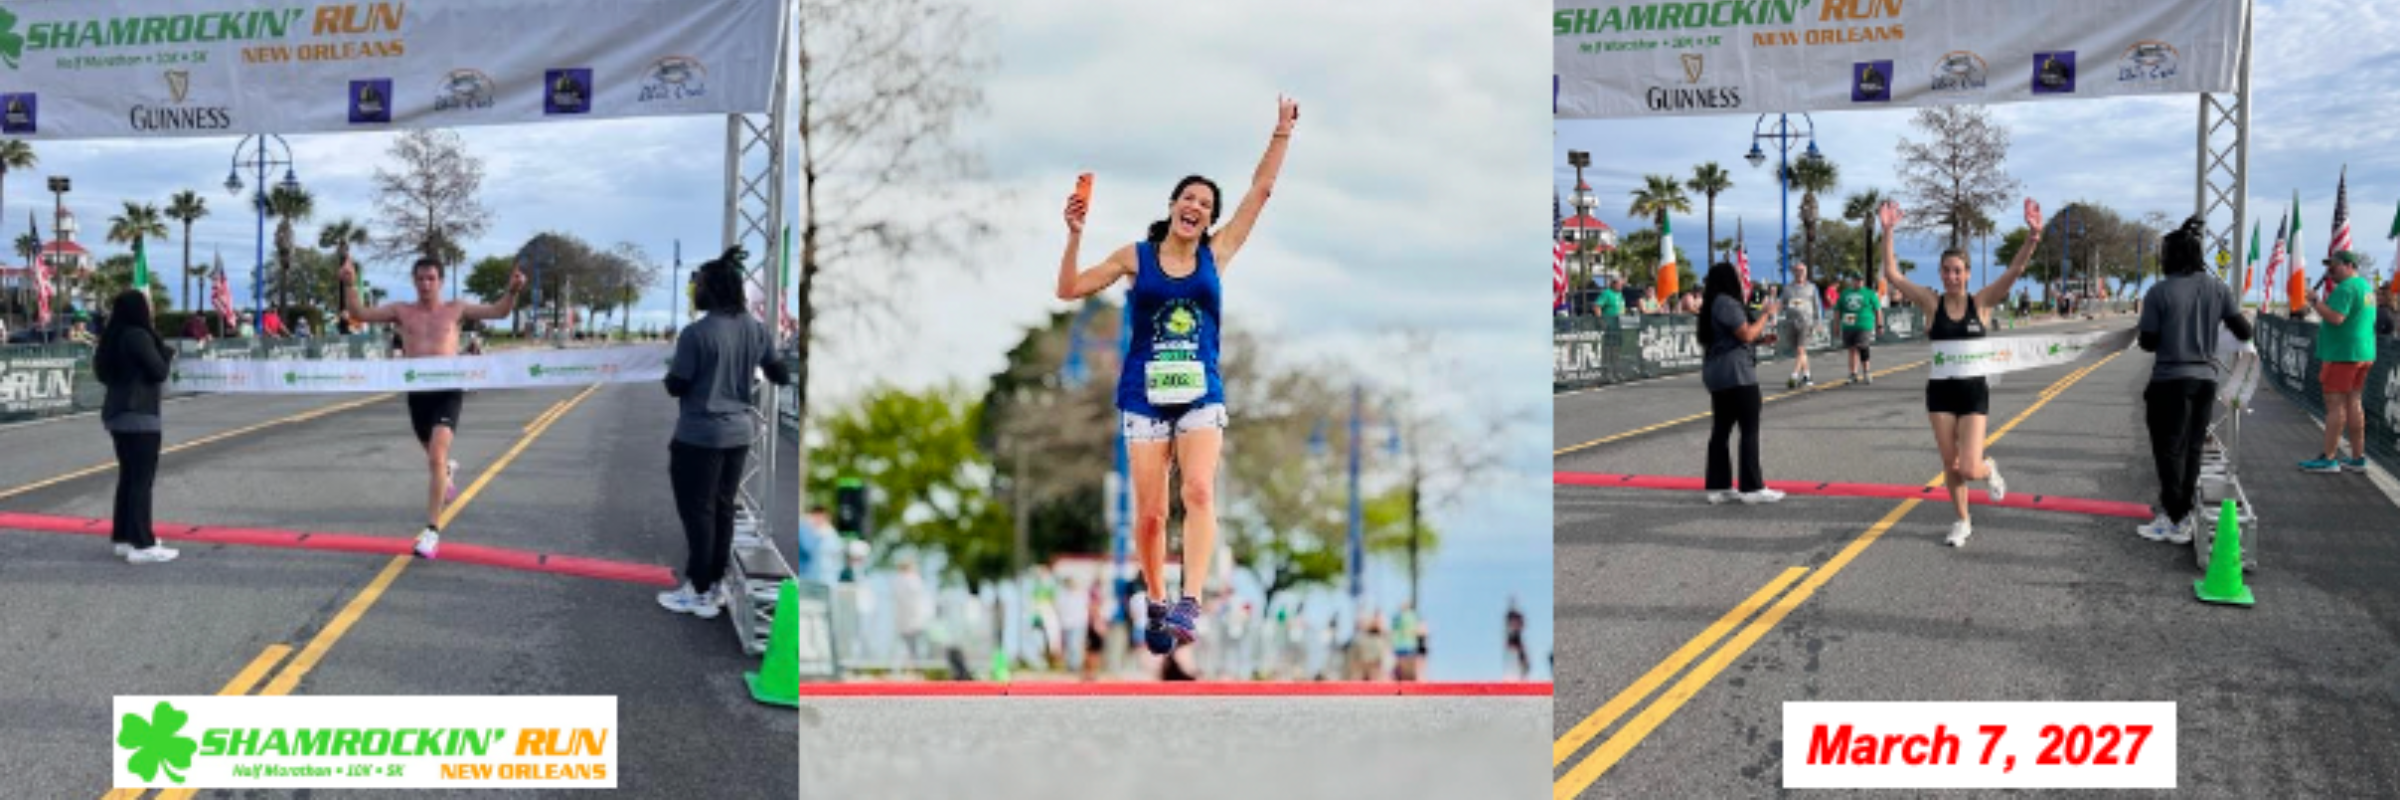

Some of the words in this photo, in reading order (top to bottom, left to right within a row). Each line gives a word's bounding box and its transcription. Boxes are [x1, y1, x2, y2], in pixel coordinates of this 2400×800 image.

[312, 2, 405, 36] RUN
[1818, 0, 1905, 22] RUN
[1752, 30, 1798, 47] NEW
[1804, 24, 1905, 46] ORLEANS
[241, 45, 290, 64] NEW
[298, 39, 405, 62] ORLEANS
[1645, 86, 1742, 111] GUINNESS
[130, 104, 231, 131] GUINNESS
